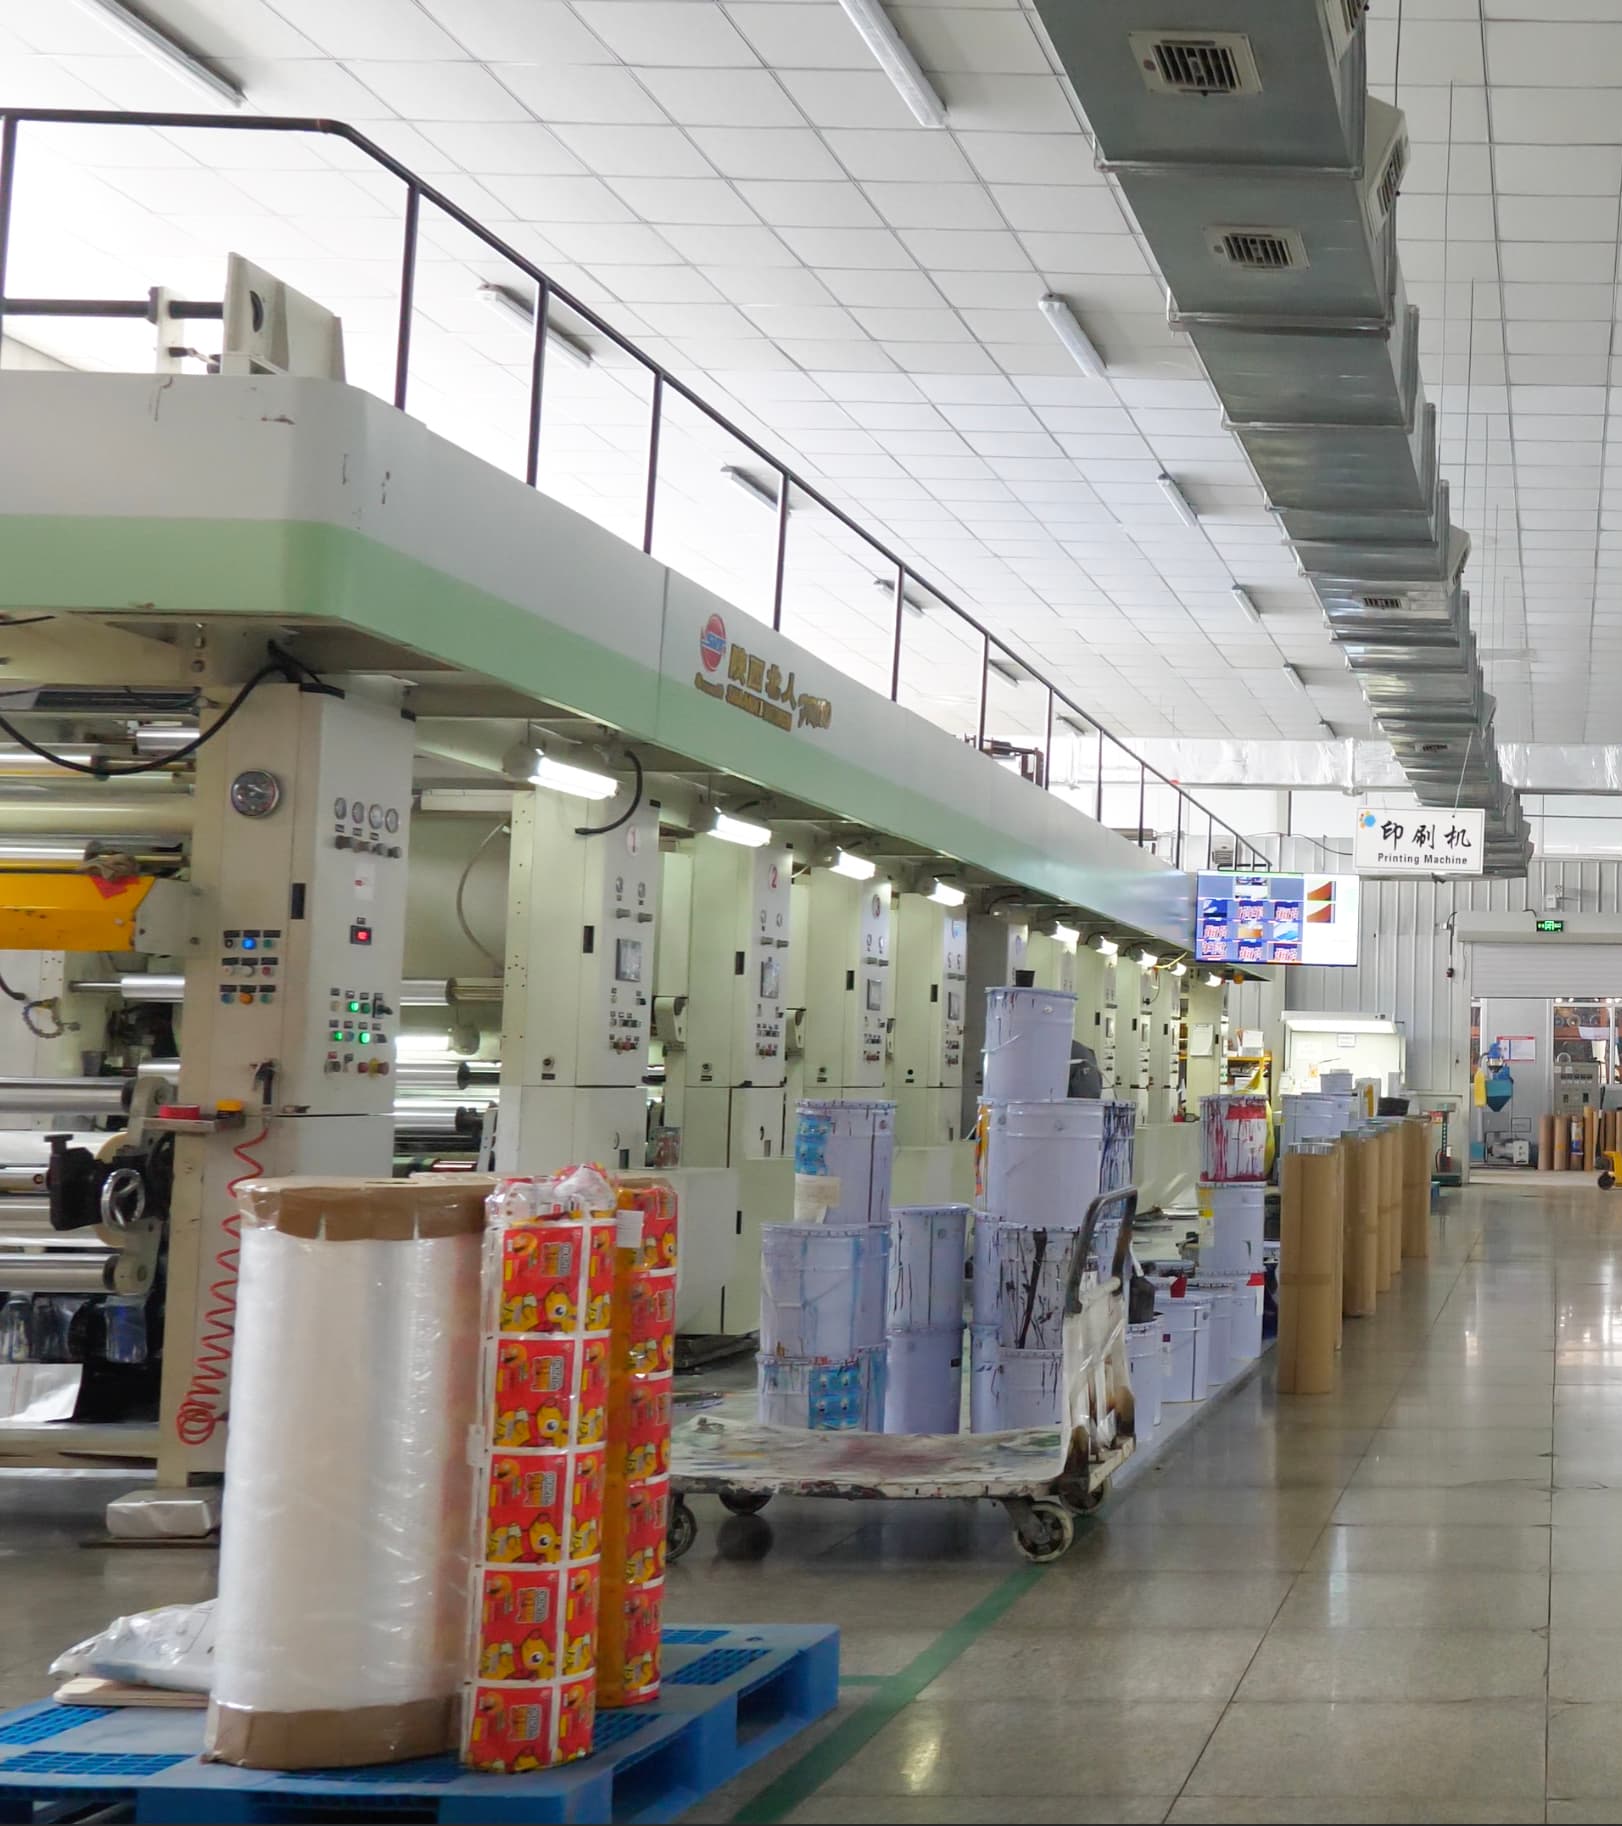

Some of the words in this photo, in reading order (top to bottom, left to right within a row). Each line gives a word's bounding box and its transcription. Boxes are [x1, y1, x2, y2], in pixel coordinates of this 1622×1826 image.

[1381, 820, 1471, 850] 印刷机
[1378, 852, 1420, 865] Printing
[1424, 854, 1468, 865] Machine
